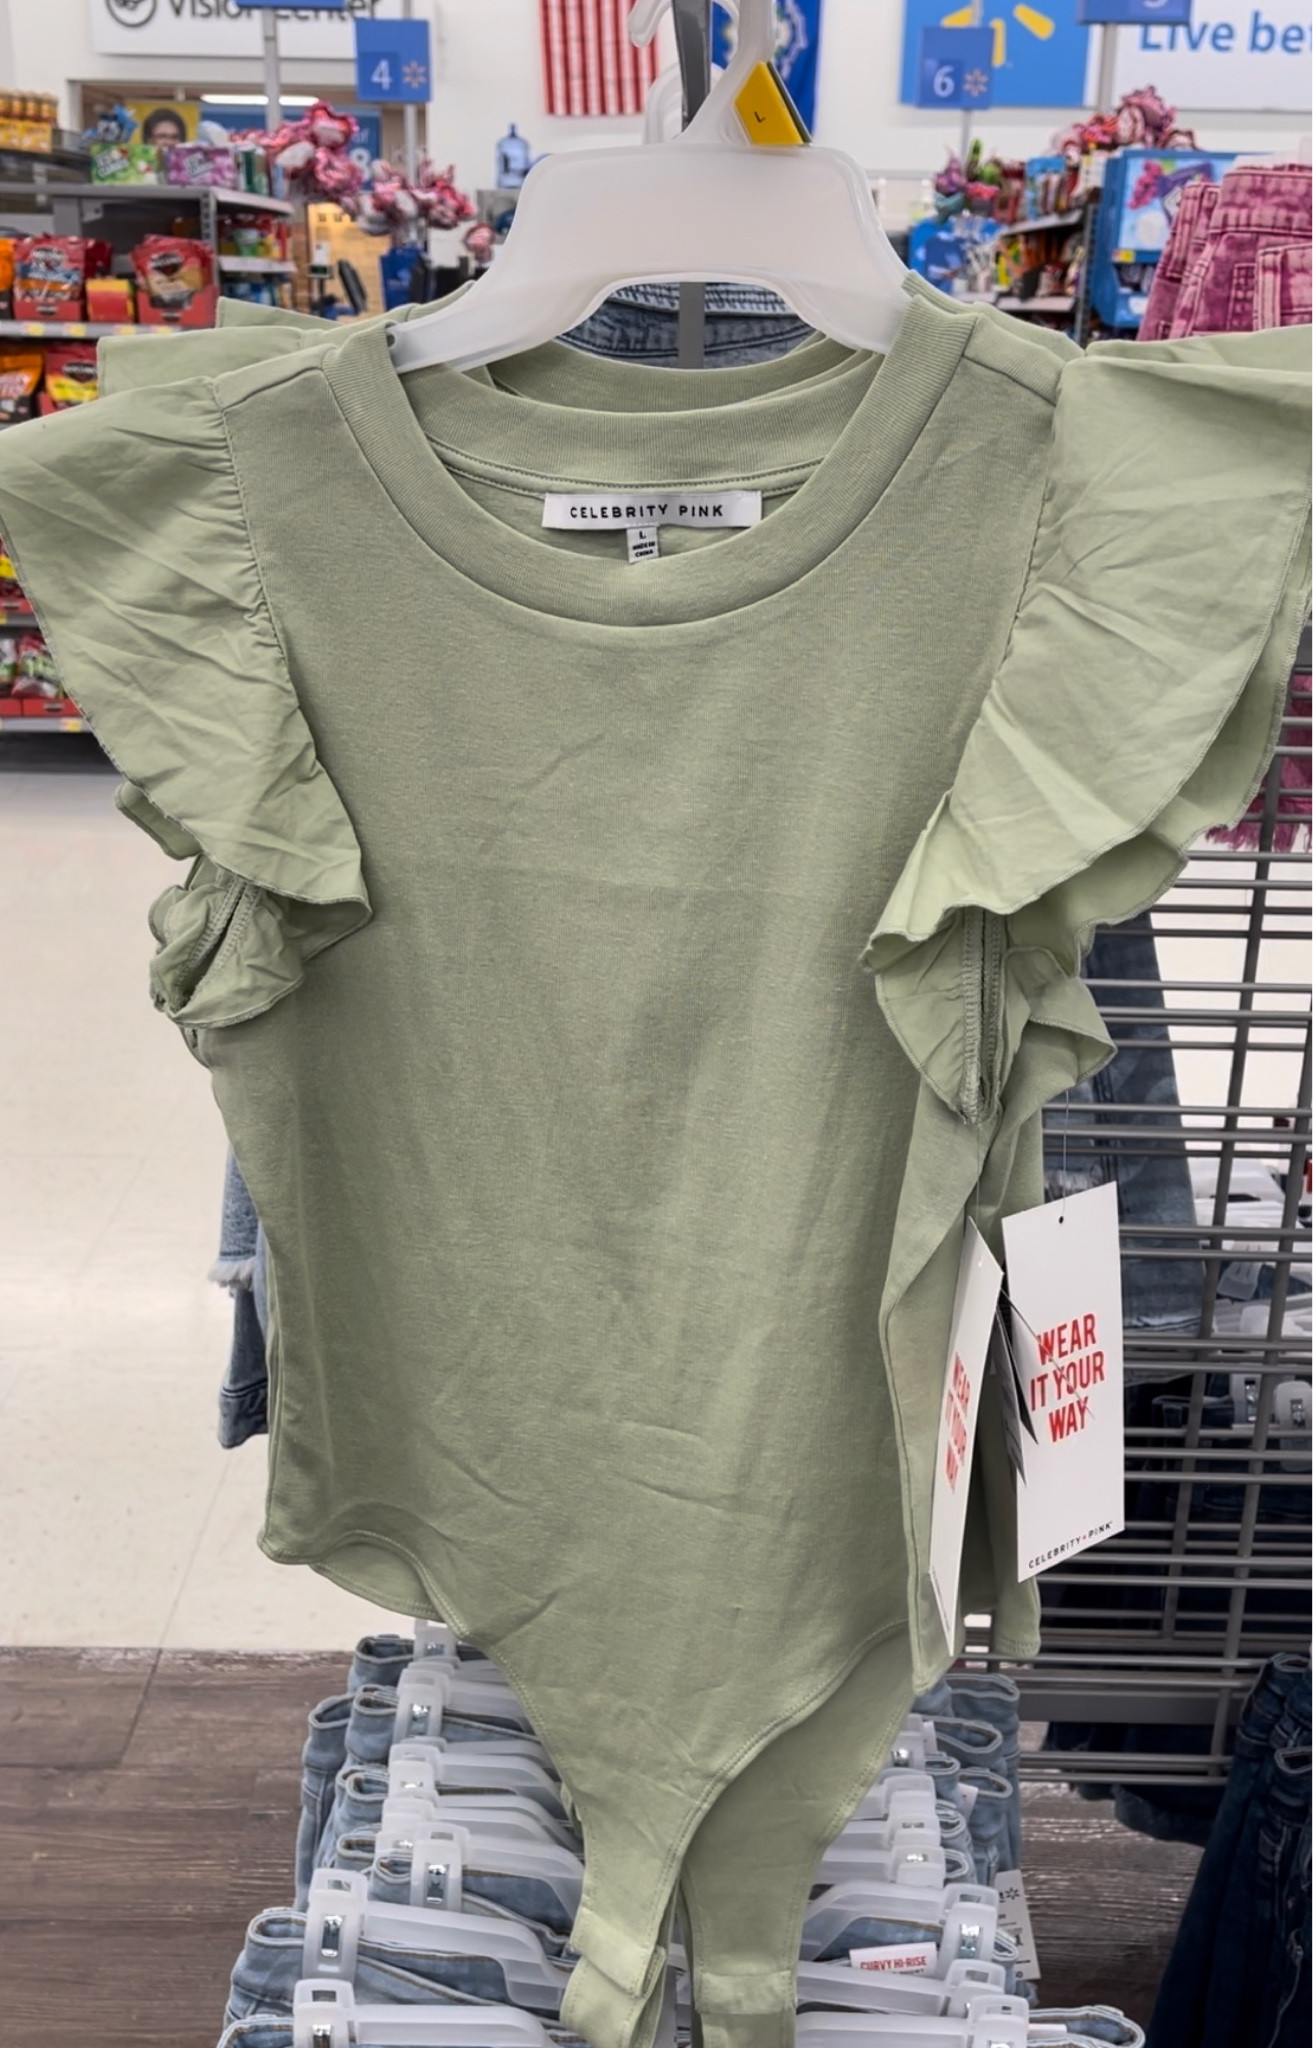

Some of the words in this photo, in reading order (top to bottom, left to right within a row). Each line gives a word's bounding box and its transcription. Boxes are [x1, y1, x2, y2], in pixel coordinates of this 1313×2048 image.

[169, 0, 253, 18] Visio
[1140, 22, 1234, 51] Live
[1250, 11, 1312, 52] be
[370, 60, 393, 90] 4
[933, 64, 955, 98] 6
[753, 110, 767, 124] L
[570, 504, 668, 519] CELEBRITY
[678, 504, 724, 518] PINK
[638, 530, 646, 539] L
[1036, 1313, 1097, 1366] WEAR
[1030, 1373, 1049, 1412] IT
[1052, 1350, 1106, 1401] YOUR
[1048, 1395, 1089, 1443] WAY
[1028, 1535, 1082, 1570] CELEBRITY
[1087, 1522, 1111, 1539] PINK
[894, 1956, 927, 1968] HI-RISE
